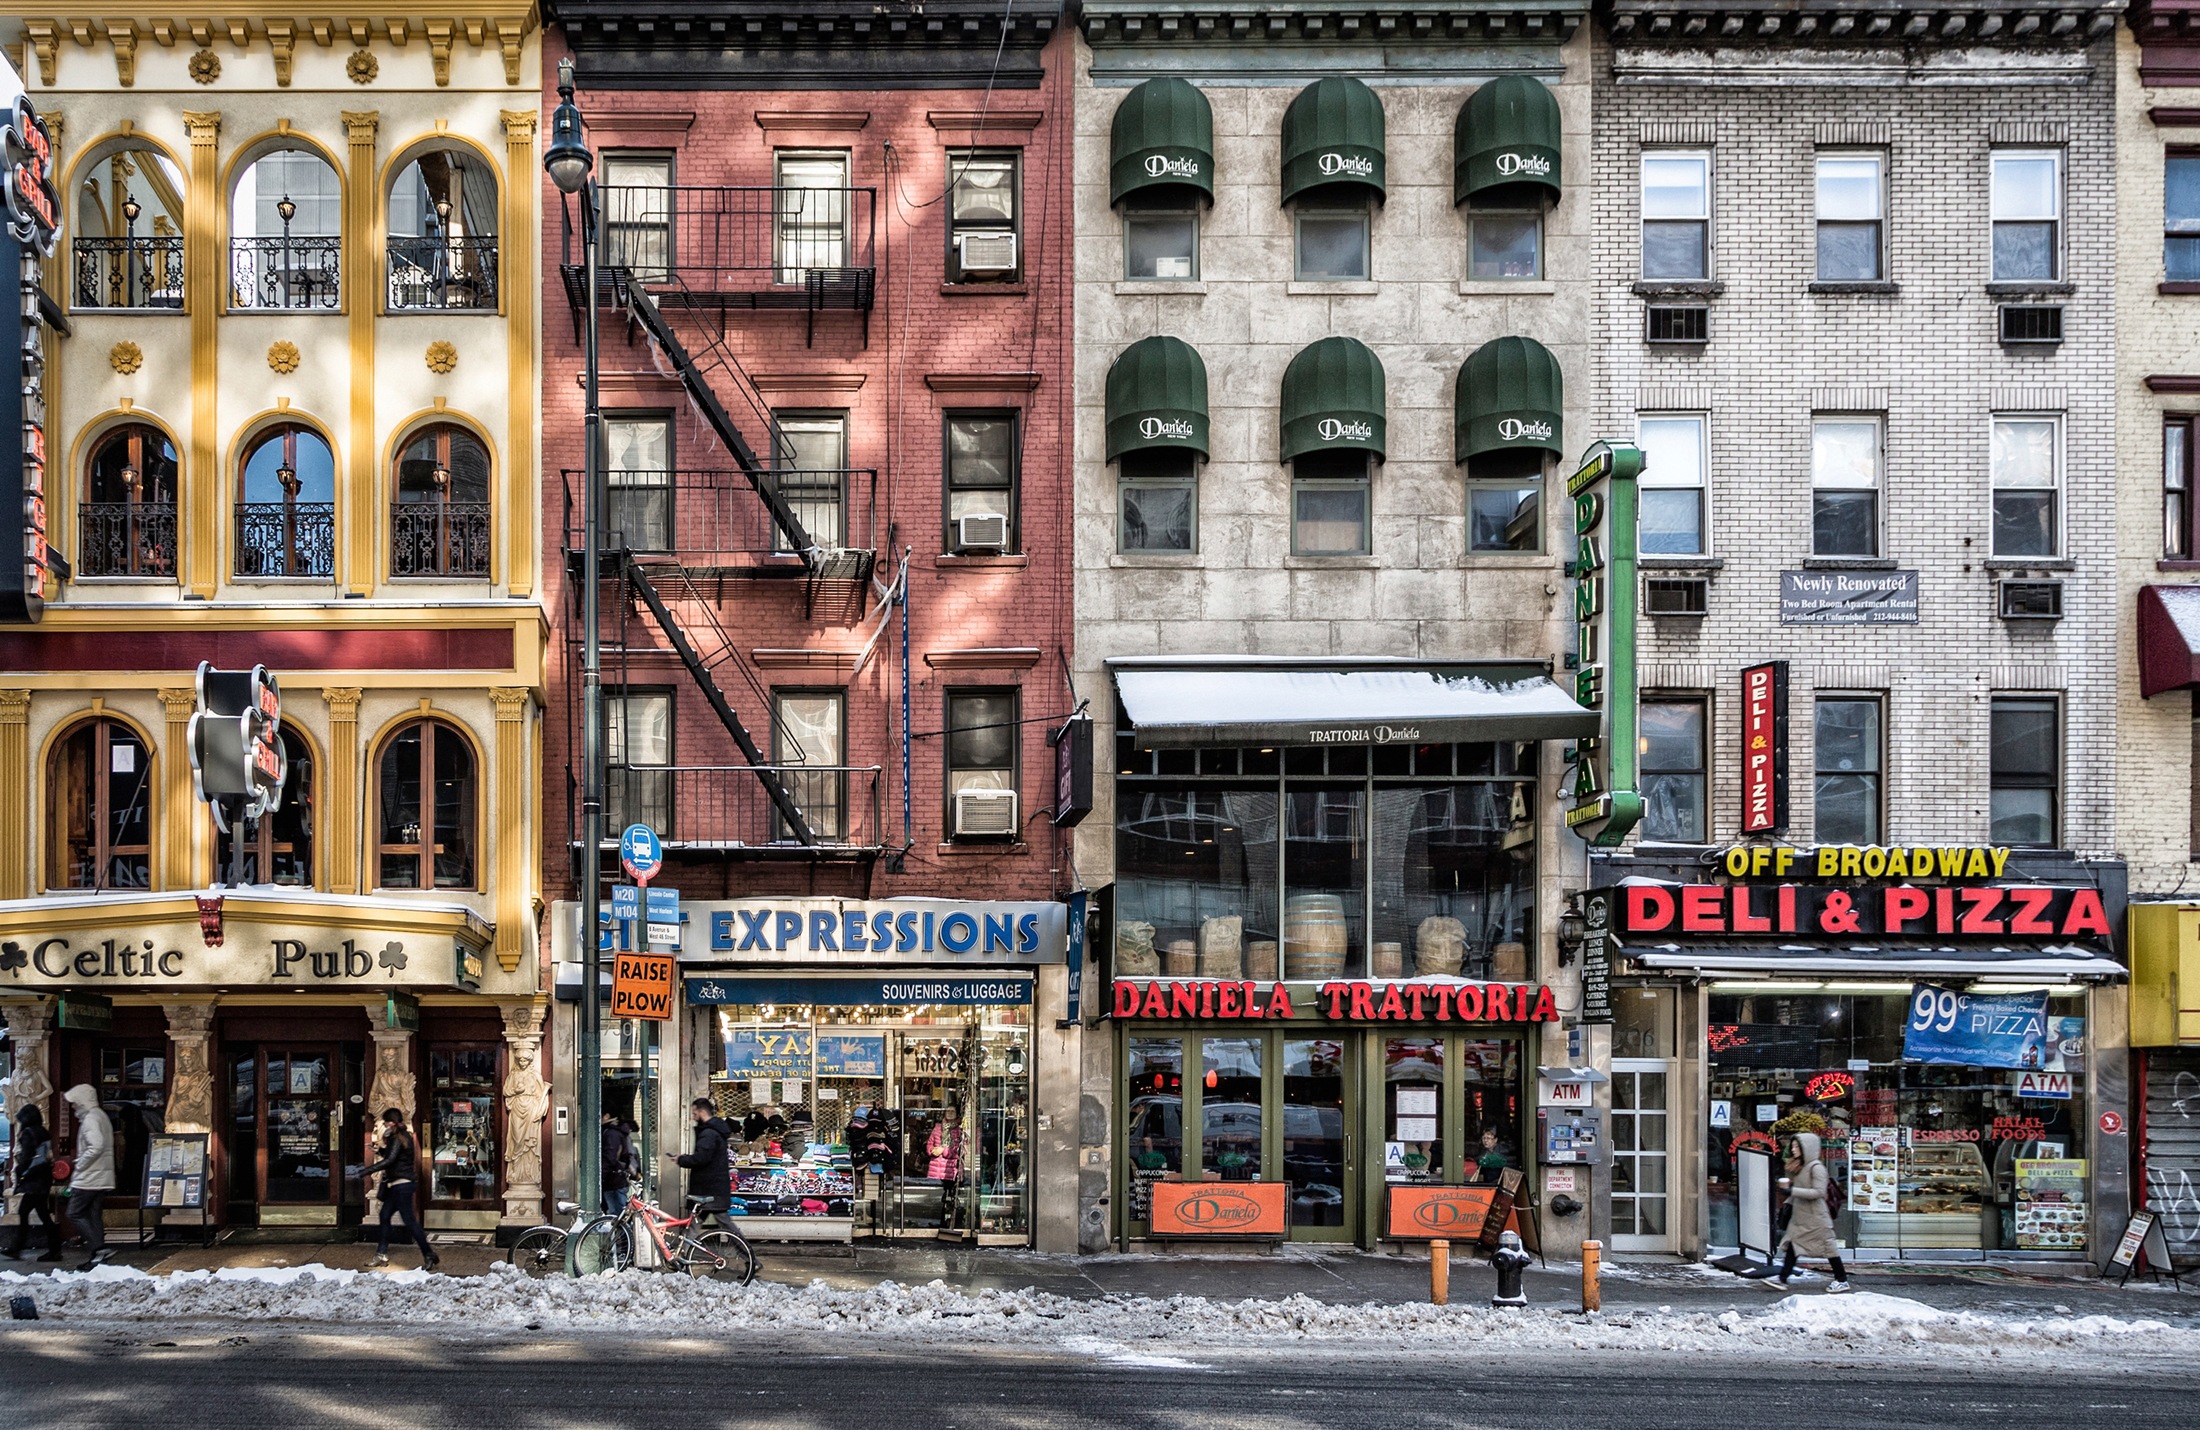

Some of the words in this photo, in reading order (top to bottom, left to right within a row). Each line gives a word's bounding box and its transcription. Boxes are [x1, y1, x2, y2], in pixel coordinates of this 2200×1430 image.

[23, 115, 49, 166] BAR
[1144, 154, 1199, 177] Daniela
[1318, 153, 1373, 176] Daniela
[1496, 153, 1551, 176] Daniela
[18, 167, 56, 230] GRILL
[1139, 417, 1194, 439] Daniela
[1317, 418, 1372, 440] Daniela
[1498, 418, 1552, 440] Daniela
[1567, 457, 1601, 494] TRATTORIA
[1792, 575, 1833, 595] Newly
[1837, 575, 1906, 591] Renovated
[1782, 599, 1799, 608] Two
[1801, 599, 1817, 608] Bed
[1819, 599, 1843, 608] Room
[1845, 600, 1888, 610] Apartment
[1890, 599, 1917, 608] Rental
[1782, 613, 1815, 621] Furnished
[1825, 613, 1867, 621] Unfurnished
[1751, 672, 1768, 730] DELI
[1309, 730, 1370, 742] TRATTORIA
[1373, 726, 1420, 743] Daniela
[1751, 735, 1768, 750] &
[1751, 755, 1768, 827] PIZZA
[1566, 800, 1601, 825] TRATTORIA
[626, 862, 635, 872] NO
[635, 864, 659, 876] STANDING
[1726, 848, 1794, 877] OFF
[1816, 847, 2011, 877] BROADWAY
[615, 889, 635, 901] M20
[615, 905, 638, 918] M104
[1626, 886, 1796, 933] DELI
[1819, 890, 1861, 934] &
[1884, 887, 2113, 936] PIZZA
[710, 909, 1041, 954] EXPRESSIONS
[32, 938, 184, 978] Celtic
[271, 939, 374, 978] Pub
[620, 961, 668, 981] RAISE
[882, 983, 950, 1000] SOUVENIRS
[951, 986, 964, 999] &
[964, 983, 1022, 1000] LUGGAGE
[2003, 994, 2034, 1004] Special
[616, 991, 668, 1012] PLOW
[1111, 980, 1296, 1019] DANIELA
[1322, 981, 1561, 1023] TRATTORIA
[1972, 1003, 1994, 1012] Freshly
[1995, 1005, 2016, 1013] Baked
[2018, 1006, 2043, 1014] Cheese
[1971, 1014, 2042, 1037] PIZZA
[147, 1063, 159, 1077] A
[295, 1073, 307, 1087] A
[1806, 1076, 1823, 1096] HOT
[1825, 1072, 1855, 1087] PIZZA
[2019, 1073, 2070, 1092] ATM
[1553, 1084, 1581, 1099] ATM
[1714, 1105, 1727, 1119] A
[1813, 1127, 1845, 1138] PASTA
[1994, 1117, 2044, 1129] HALAL
[1913, 1129, 1980, 1142] ESPRESSO
[1992, 1128, 2046, 1140] FOODS
[1389, 1145, 1400, 1160] A
[1397, 1169, 1430, 1177] CAPPUCCINO
[1191, 1188, 1245, 1198] TRATTORIA
[1429, 1192, 1484, 1203] TRATTORIA
[1181, 1199, 1256, 1223] Daniela
